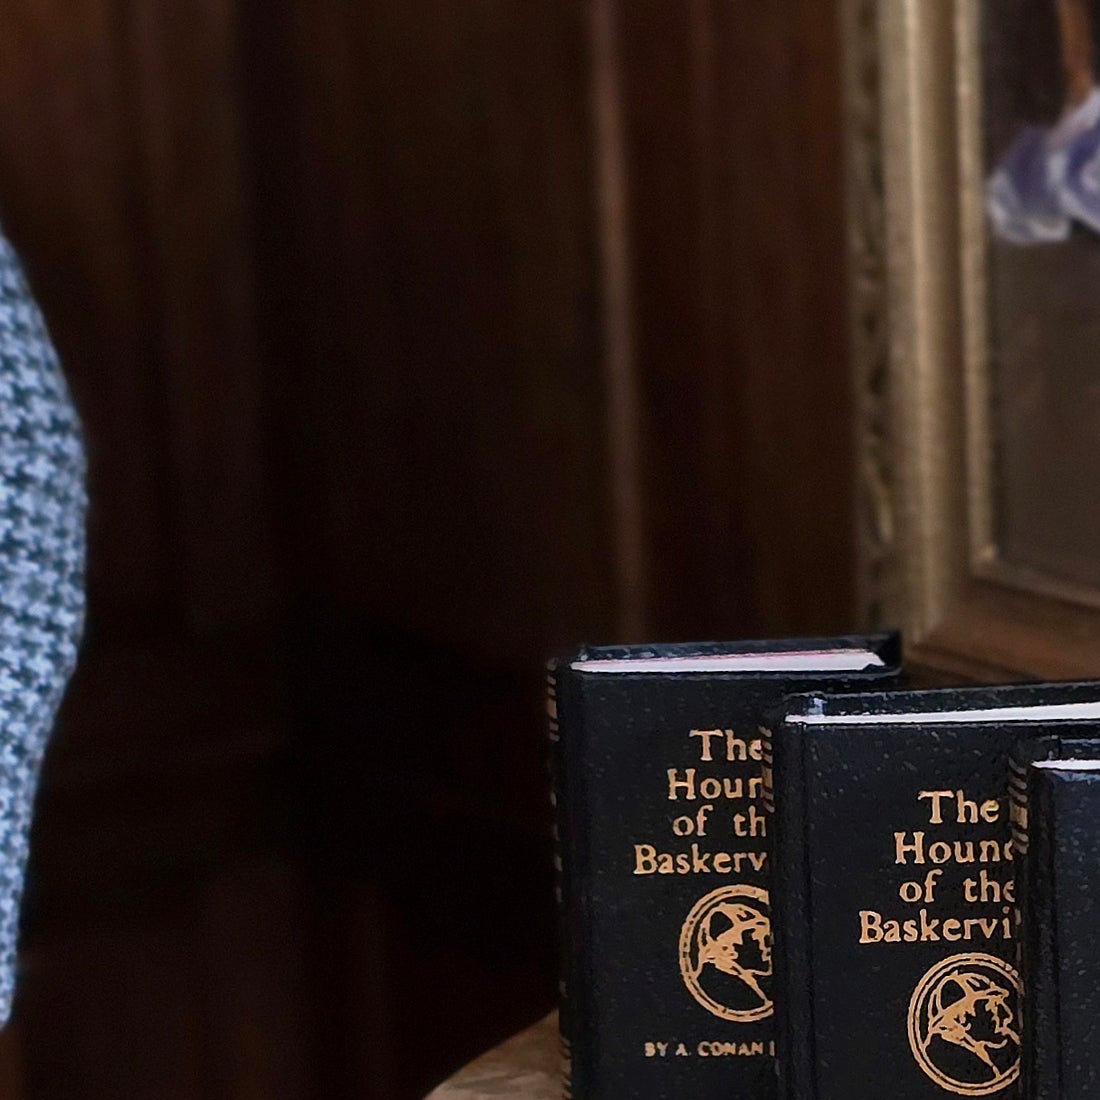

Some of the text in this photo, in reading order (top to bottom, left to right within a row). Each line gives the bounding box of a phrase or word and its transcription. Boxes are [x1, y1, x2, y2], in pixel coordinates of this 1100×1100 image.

[688, 728, 764, 762] The
[672, 803, 768, 838] of th
[917, 788, 1001, 825] The
[633, 842, 768, 875] Baskerv
[899, 867, 1016, 904] of the
[858, 907, 1013, 944] Baskervi
[643, 1041, 669, 1057] BY
[697, 1040, 764, 1057] CONAN
